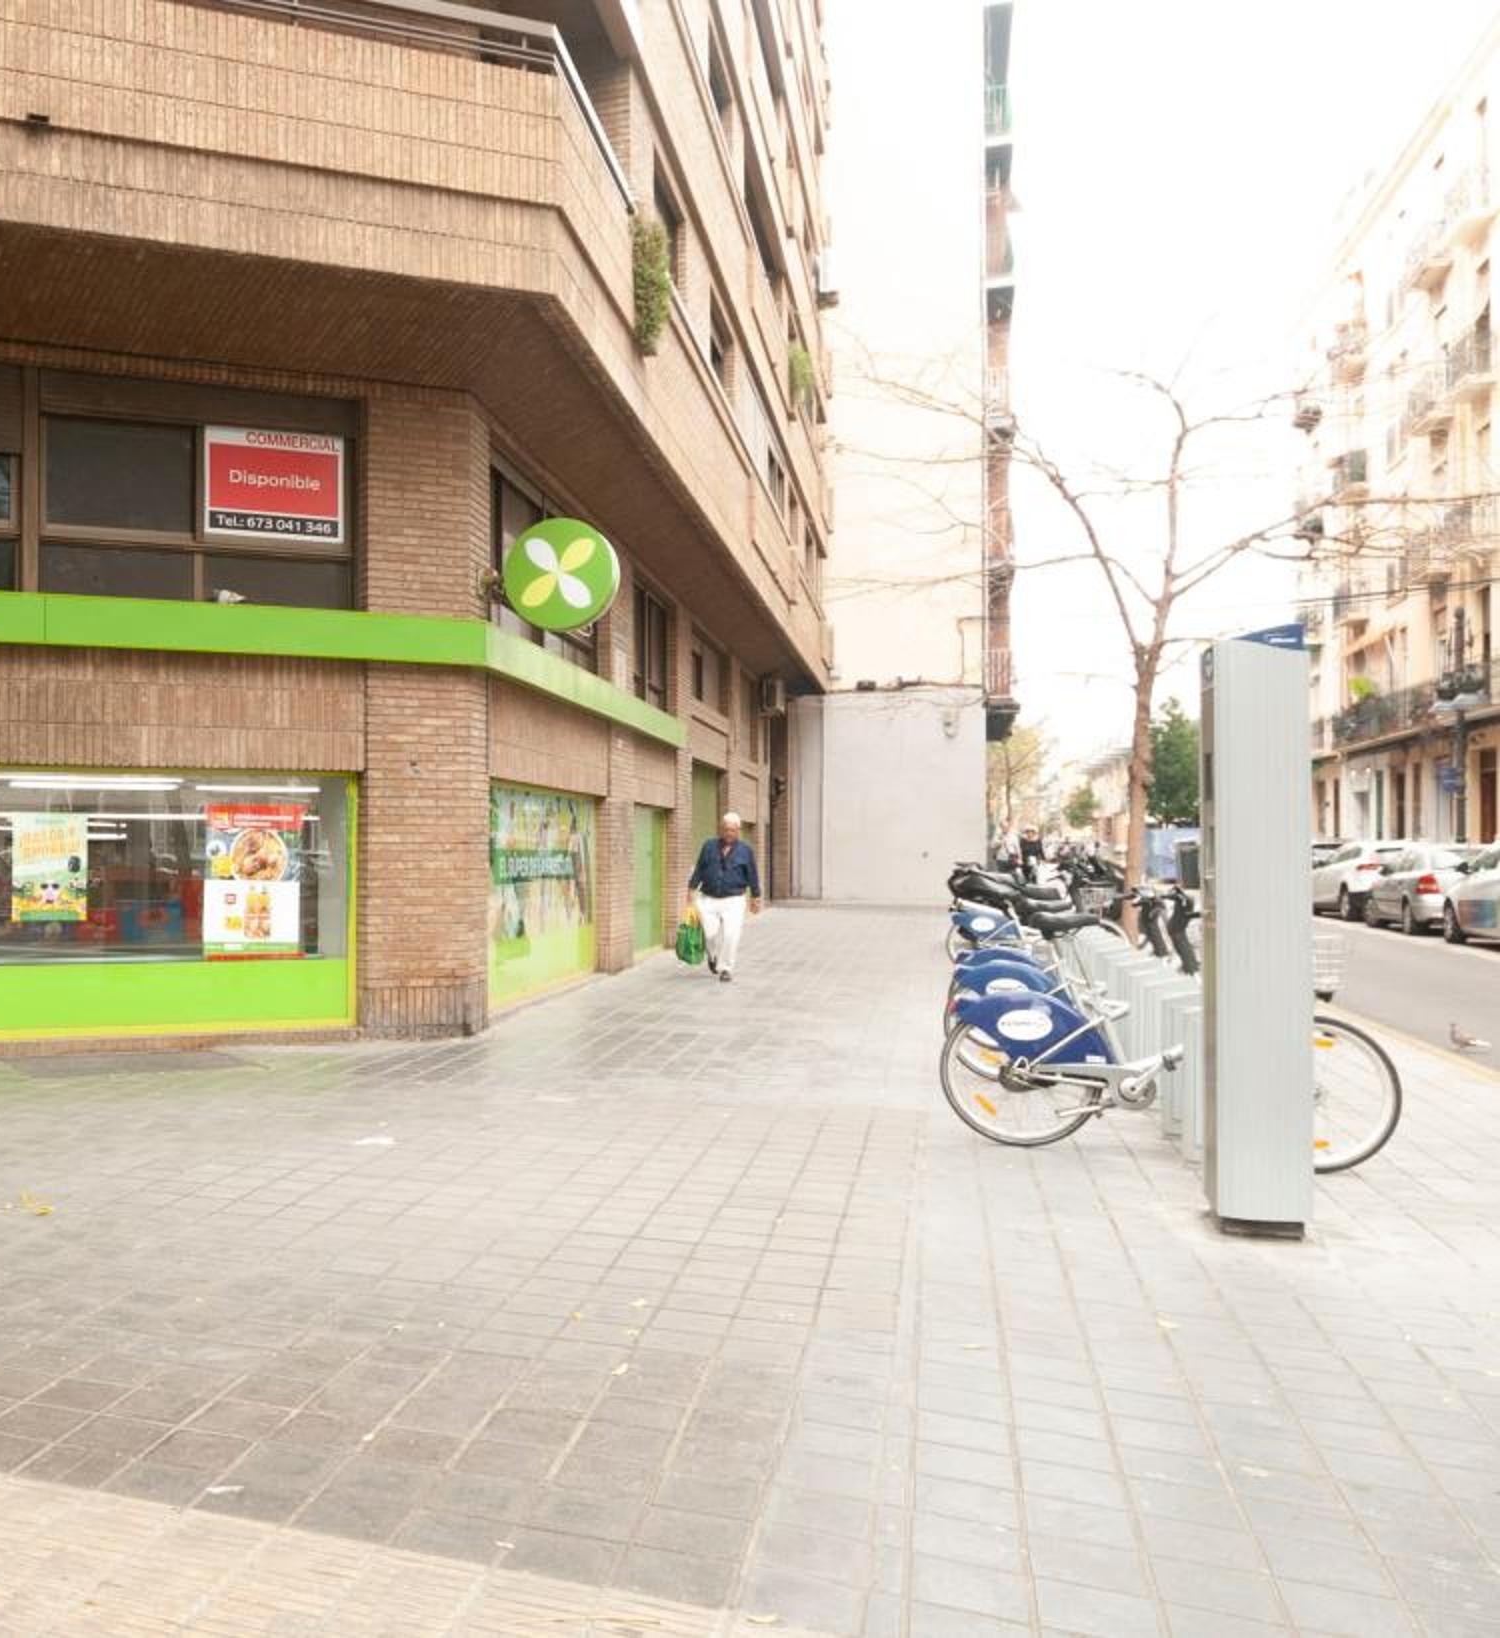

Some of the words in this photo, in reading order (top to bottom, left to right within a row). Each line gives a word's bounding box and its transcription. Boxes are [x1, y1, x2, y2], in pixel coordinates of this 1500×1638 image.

[245, 431, 340, 451] COMMERCIAL
[228, 469, 321, 491] Disponible
[247, 517, 273, 530] 673
[275, 519, 301, 532] 041
[305, 521, 331, 535] 346
